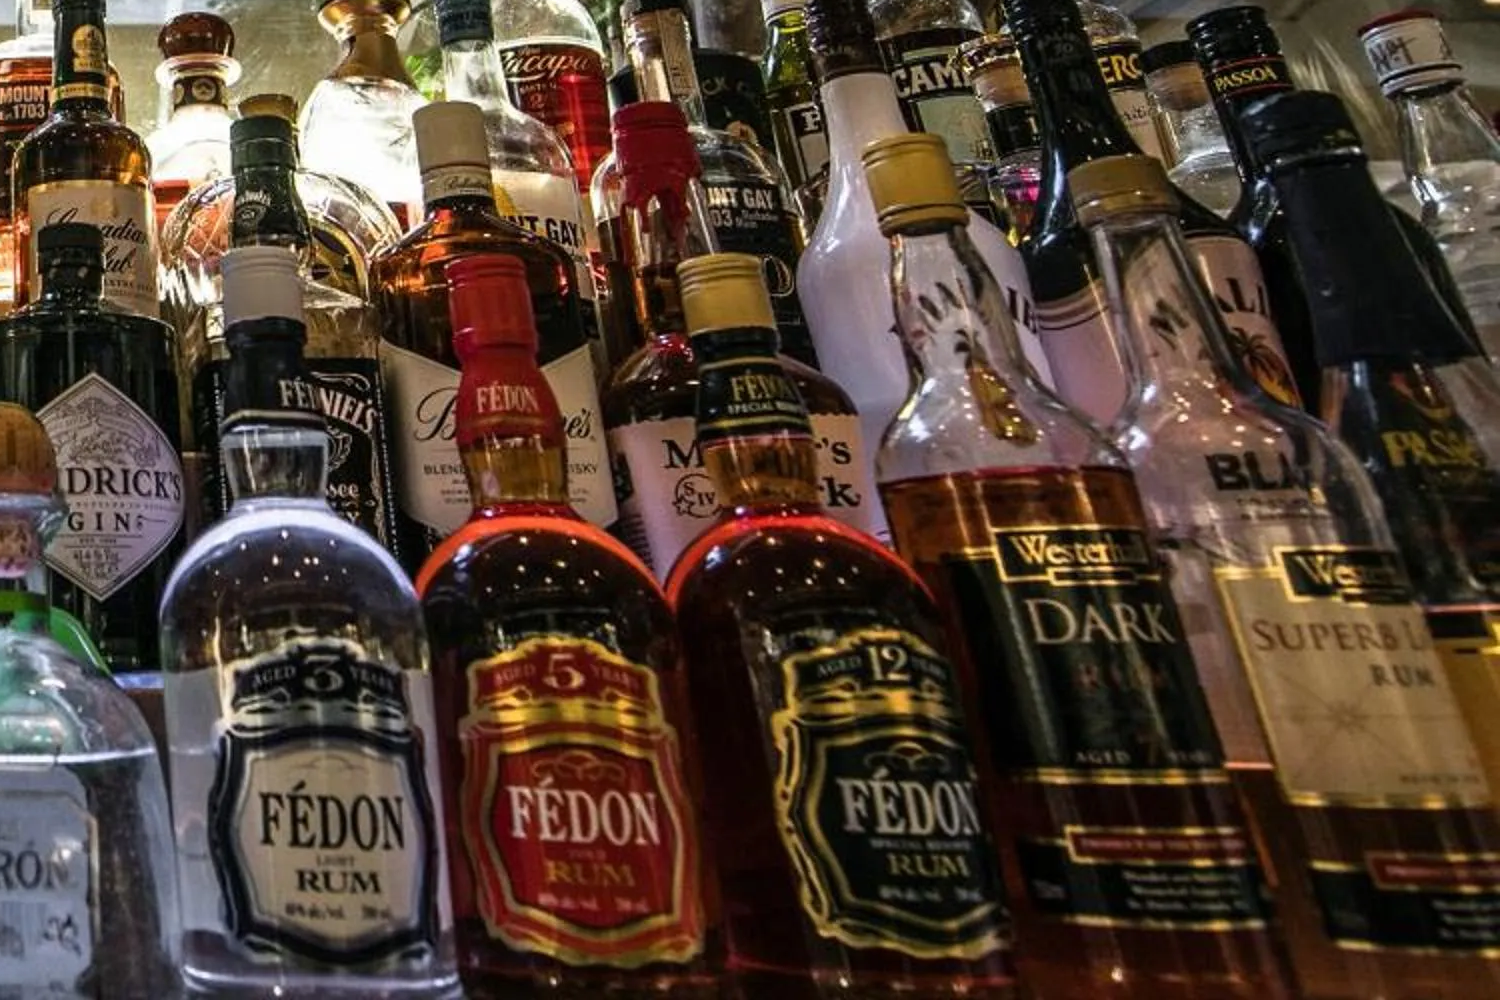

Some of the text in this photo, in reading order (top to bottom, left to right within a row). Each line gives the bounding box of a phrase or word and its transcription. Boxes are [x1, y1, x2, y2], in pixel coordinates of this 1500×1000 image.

[12, 105, 45, 120] 1703
[741, 189, 774, 211] GAY
[544, 217, 579, 247] GAY
[476, 379, 540, 414] FÉDON
[66, 465, 182, 503] DRICK'S
[67, 512, 130, 533] GIN
[1027, 600, 1176, 645] DARK
[1252, 619, 1399, 652] SUPERB
[251, 663, 298, 689] AGED
[303, 654, 345, 693] 3
[492, 664, 537, 687] AGED
[543, 653, 585, 690] 5
[867, 645, 913, 682] 12
[259, 779, 406, 851] FÉDON
[505, 777, 662, 847] FÉDON
[836, 768, 981, 838] FÉDON
[294, 869, 383, 895] RUM
[546, 860, 637, 888] RUM
[887, 852, 971, 878] RUM
